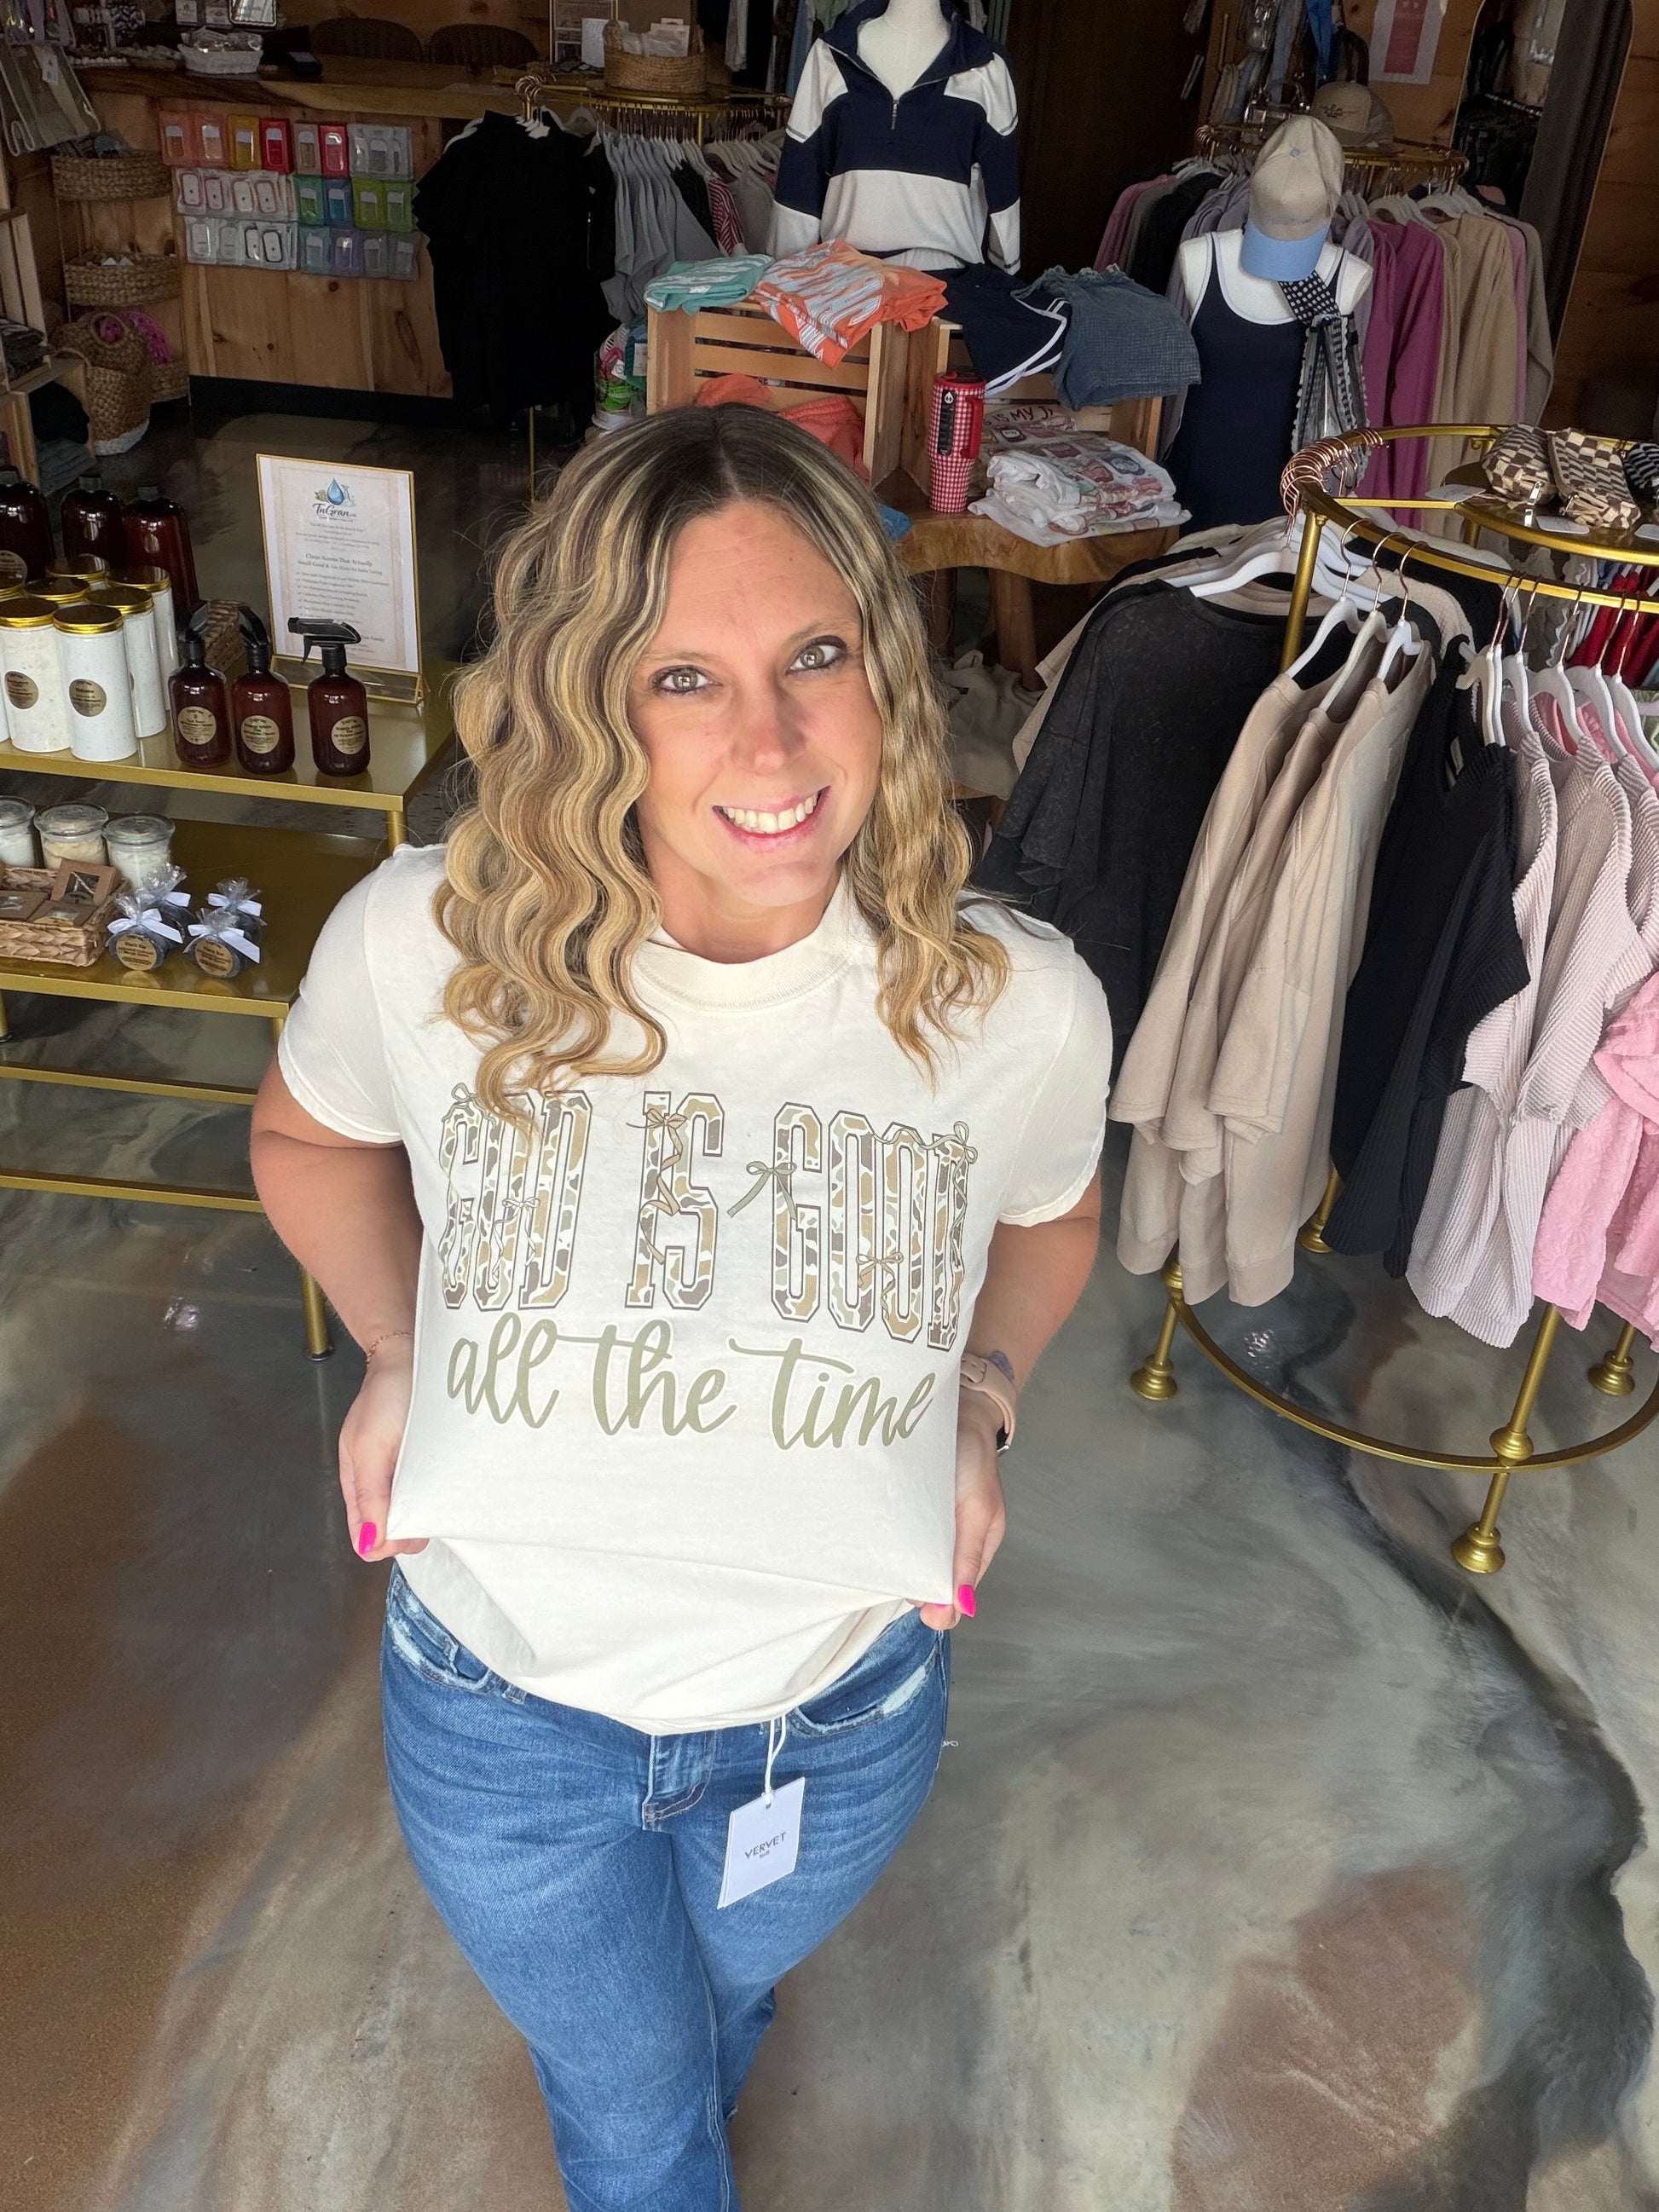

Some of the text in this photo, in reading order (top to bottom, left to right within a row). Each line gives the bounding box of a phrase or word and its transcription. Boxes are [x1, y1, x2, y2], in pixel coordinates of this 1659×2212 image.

[1009, 407, 1034, 421] MY
[439, 1090, 972, 1353] GOD IS GOOD
[447, 1311, 937, 1451] all the time
[744, 1831, 787, 1860] VERVET
